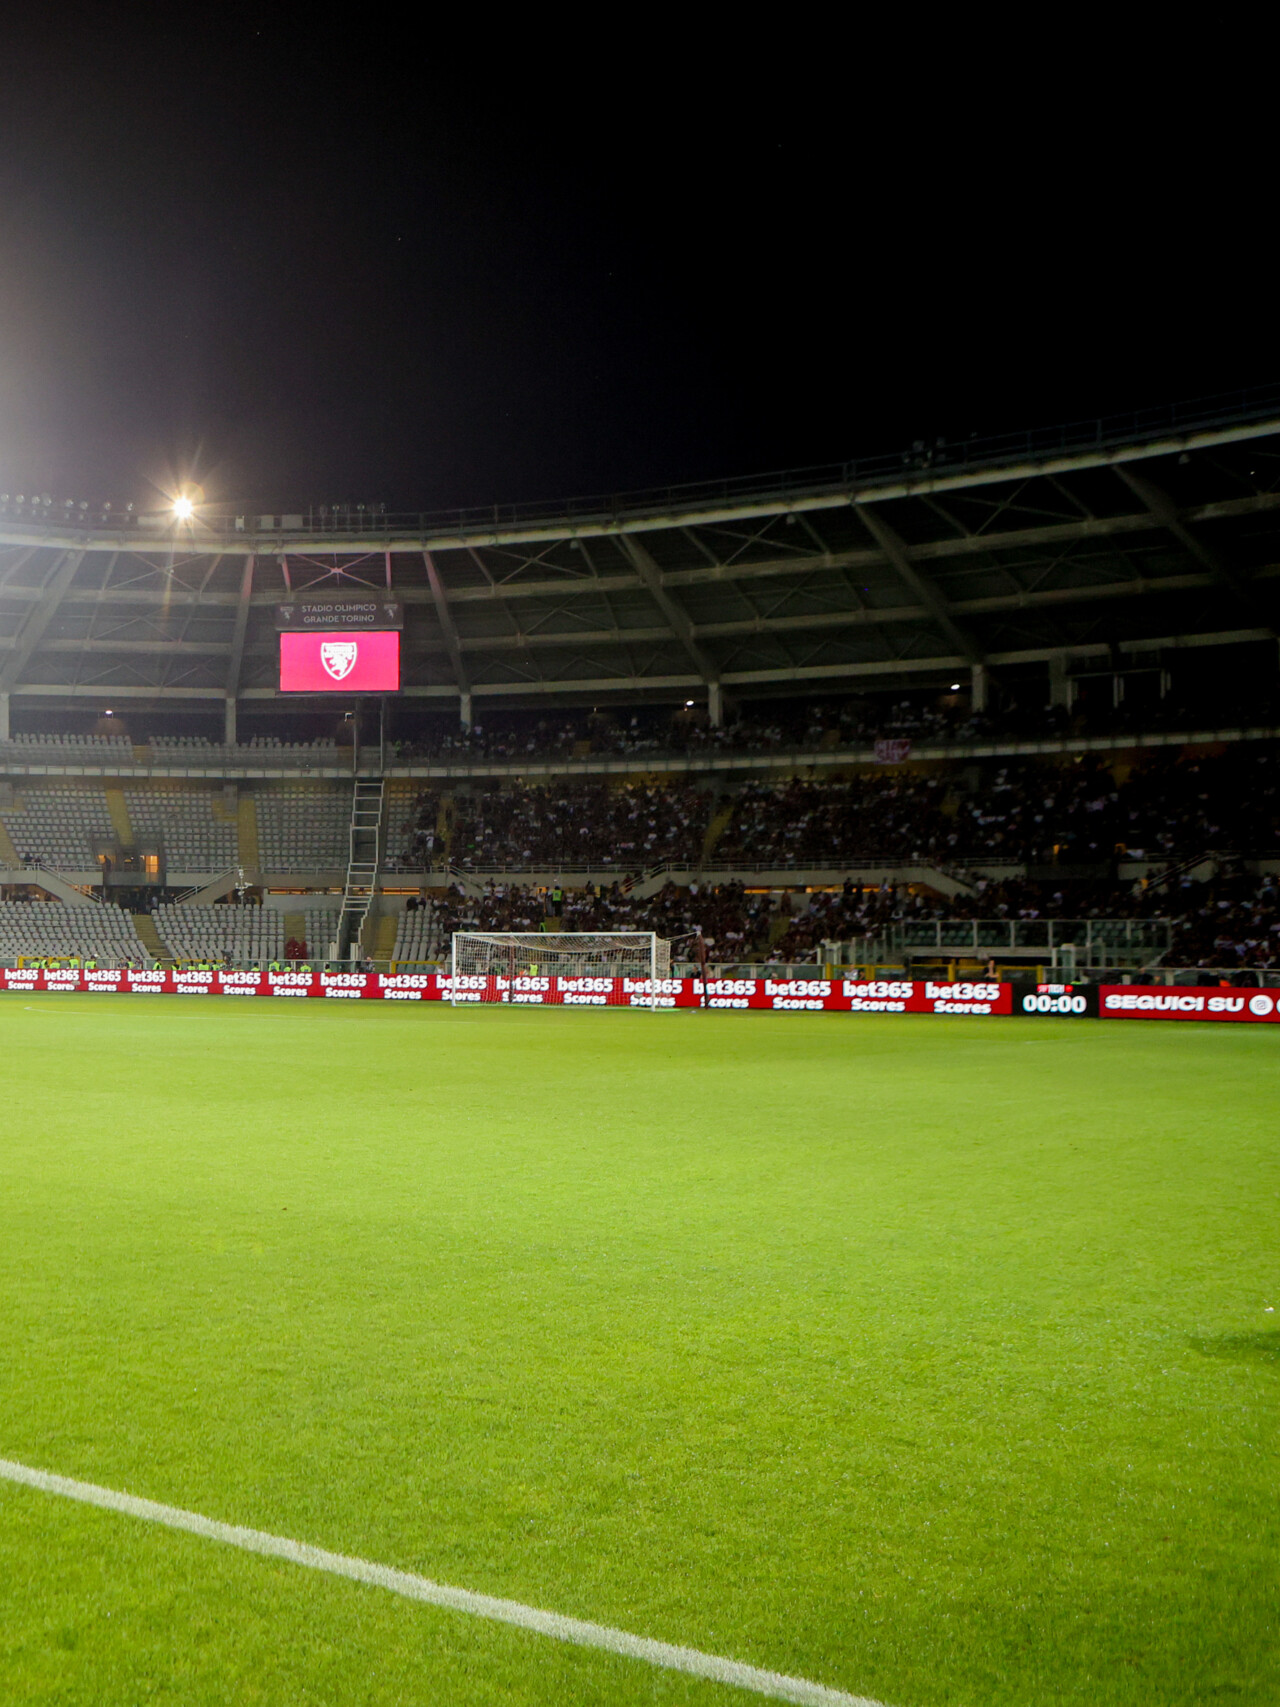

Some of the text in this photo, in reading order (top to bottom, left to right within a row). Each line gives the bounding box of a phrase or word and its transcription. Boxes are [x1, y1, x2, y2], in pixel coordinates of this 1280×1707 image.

[301, 603, 377, 612] STADIO OLIMPICO
[304, 614, 375, 623] GRANDE TORINO
[5, 969, 38, 982] bet365
[44, 968, 79, 983] bet365
[84, 970, 121, 983] bet365
[128, 970, 165, 984] bet365
[173, 971, 212, 985] bet365
[219, 971, 260, 986] bet365
[269, 972, 312, 987] bet365
[321, 973, 366, 989] bet365
[8, 981, 33, 989] Scores
[48, 982, 74, 990] Scores
[89, 982, 116, 991] Scores
[132, 983, 161, 992] Scores
[379, 974, 427, 990] bet365
[558, 977, 613, 994] bet365
[177, 984, 208, 993] Scores
[224, 985, 255, 994] Scores
[274, 986, 307, 996] Scores
[326, 988, 361, 997] Scores
[385, 989, 421, 999] Scores
[766, 980, 831, 998] bet365
[844, 981, 912, 1000] bet365
[926, 982, 999, 999] bet365
[564, 993, 606, 1004] Scores
[773, 997, 823, 1009] Scores
[852, 999, 904, 1010] Scores
[1023, 995, 1087, 1013] 00:00
[1105, 995, 1245, 1012] SEGUICI SU
[935, 1001, 991, 1013] Scores
